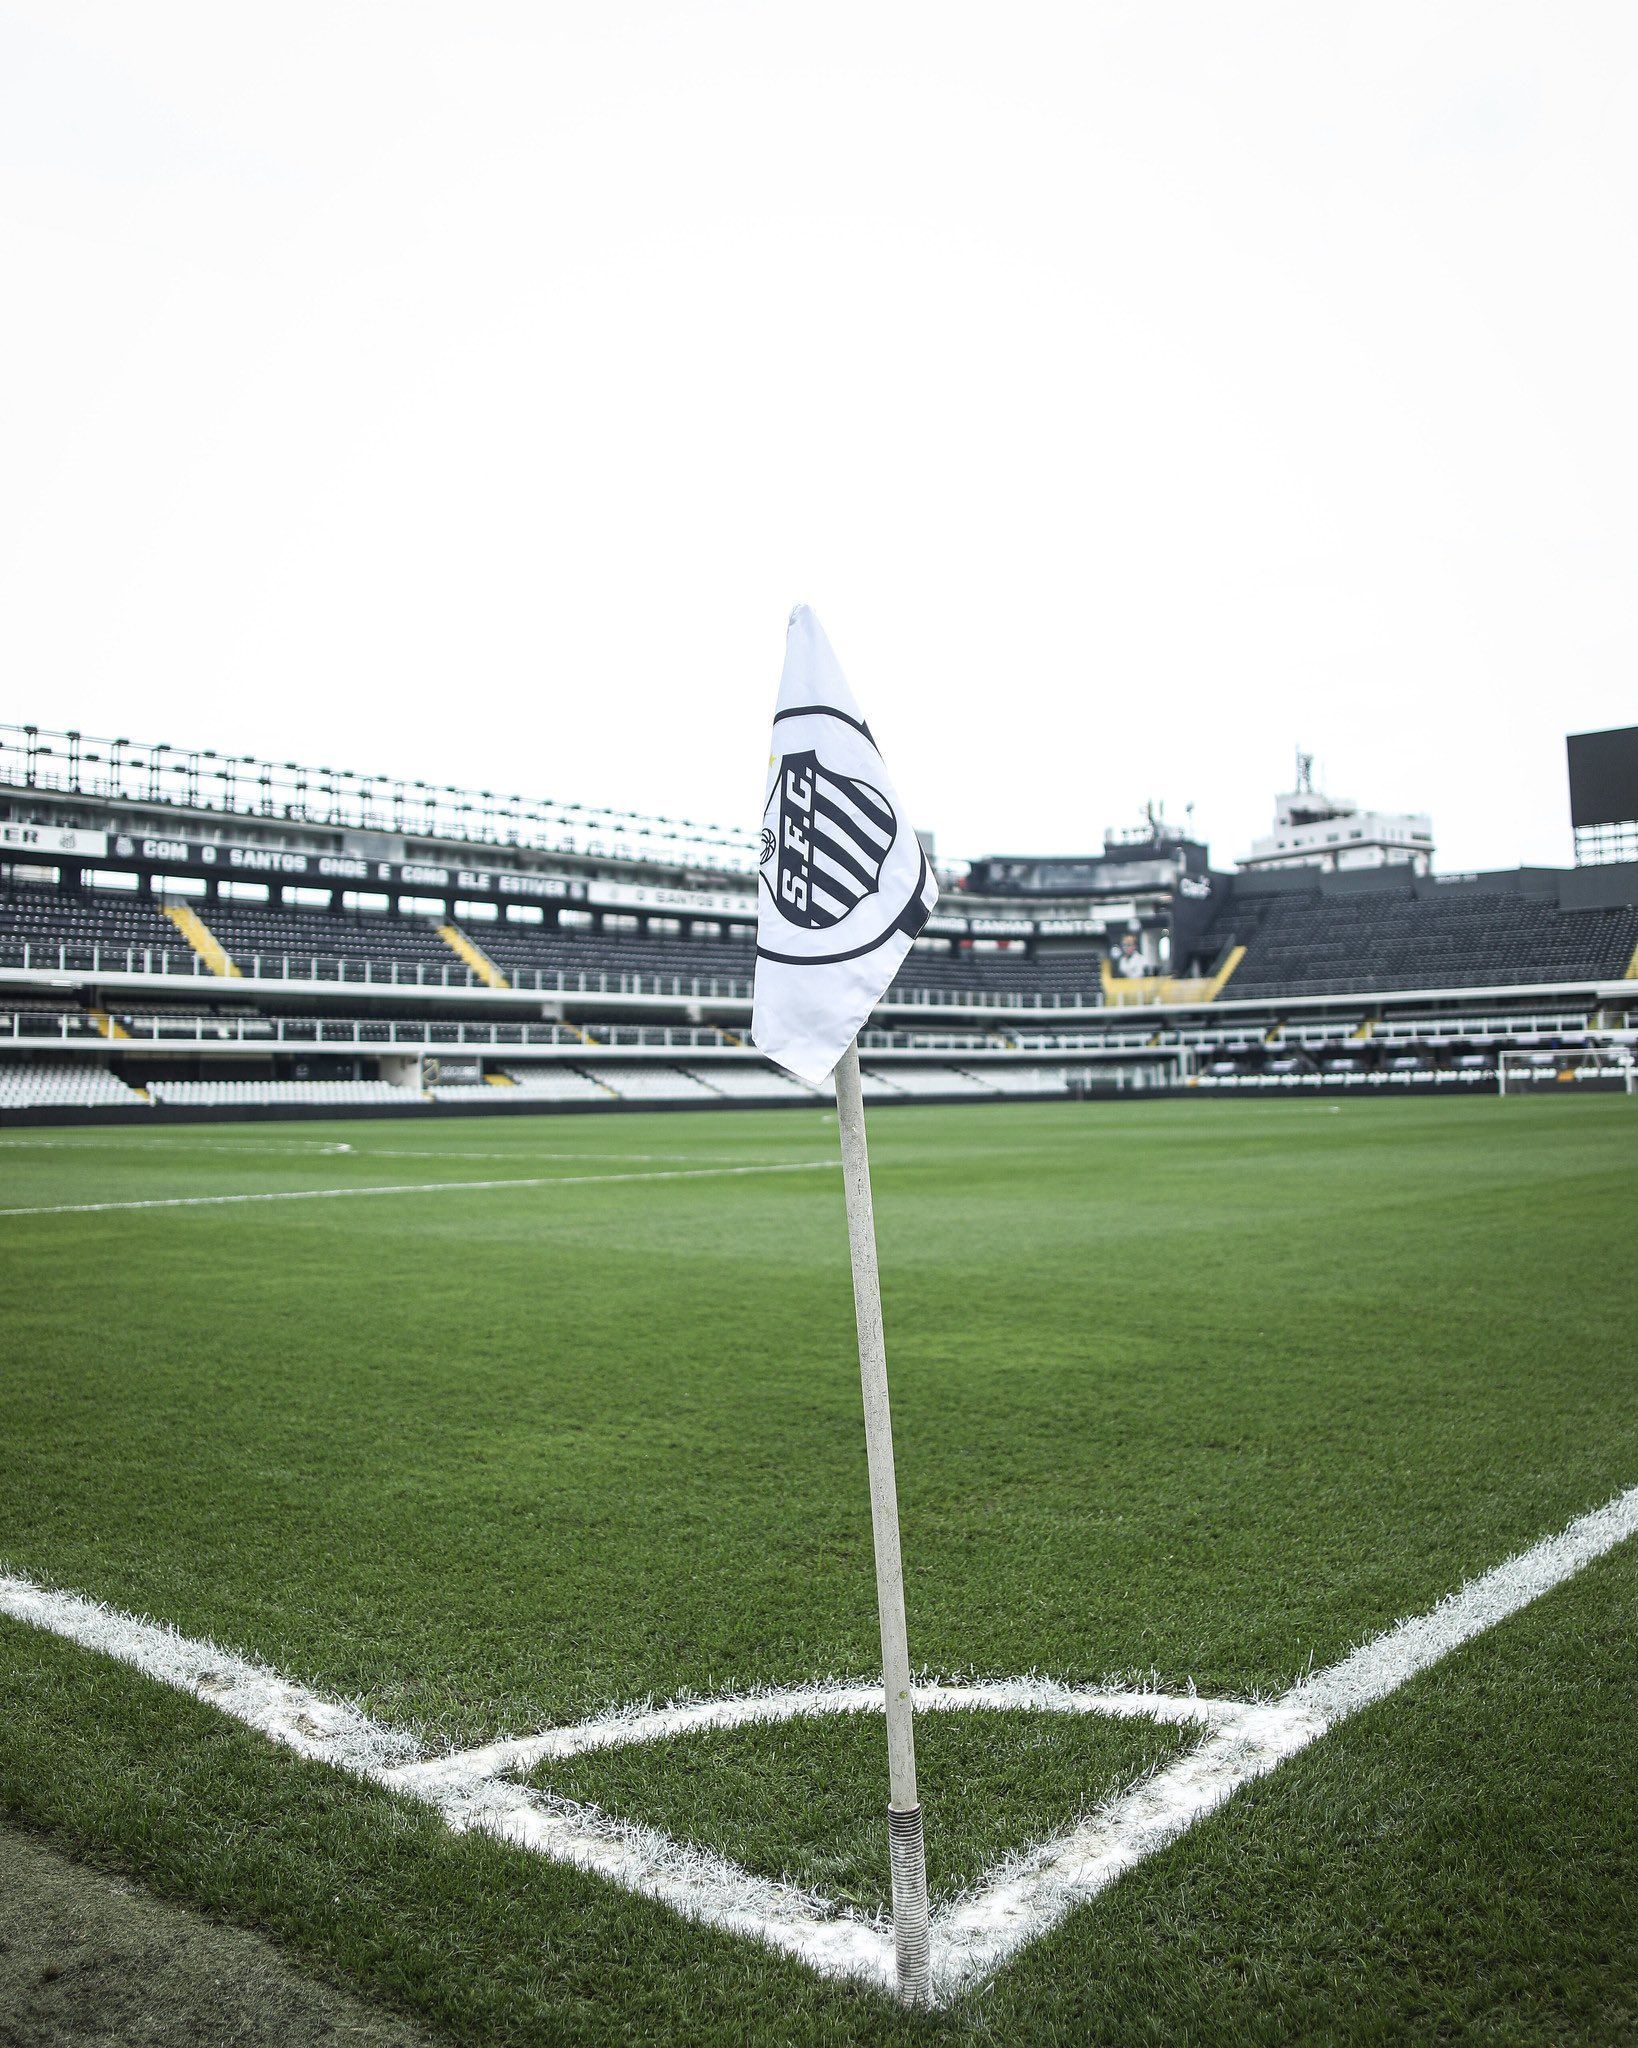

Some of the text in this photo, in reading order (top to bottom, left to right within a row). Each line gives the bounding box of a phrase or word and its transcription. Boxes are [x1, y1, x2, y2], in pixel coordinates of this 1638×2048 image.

[143, 840, 188, 862] COM
[202, 845, 217, 865] O
[230, 849, 307, 873] SANTOS
[458, 871, 491, 892] ELE
